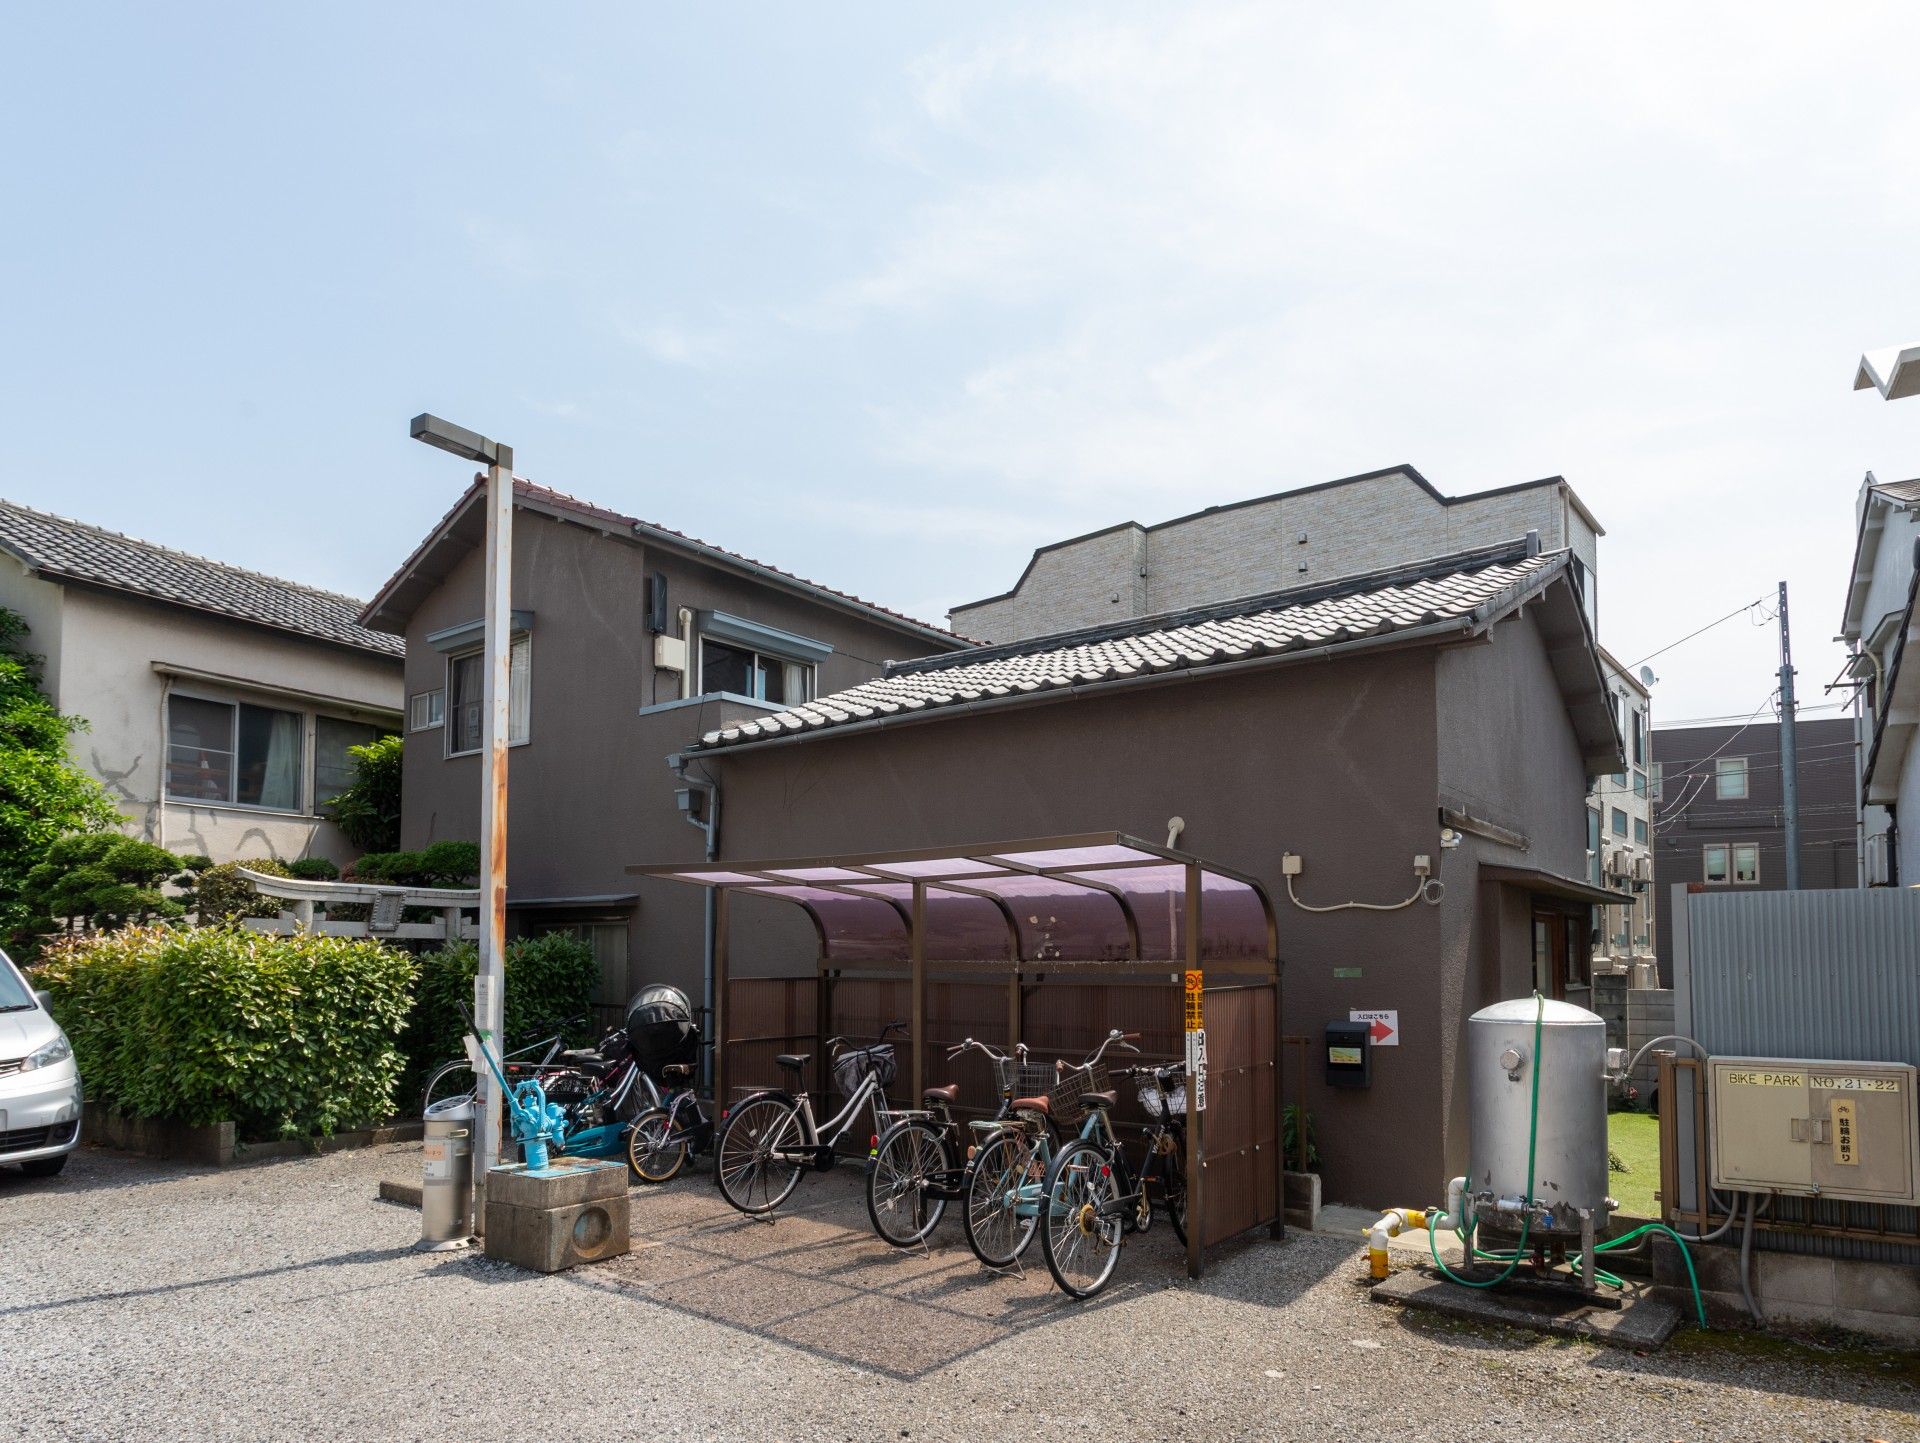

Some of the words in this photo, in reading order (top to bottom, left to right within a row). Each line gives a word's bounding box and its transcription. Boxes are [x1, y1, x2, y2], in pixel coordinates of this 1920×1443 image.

[1186, 992, 1196, 1029] 駐輪禁止
[1729, 1073, 1758, 1086] BIKE
[1764, 1074, 1801, 1087] PARK
[1839, 1117, 1851, 1162] 駐輪お断り
